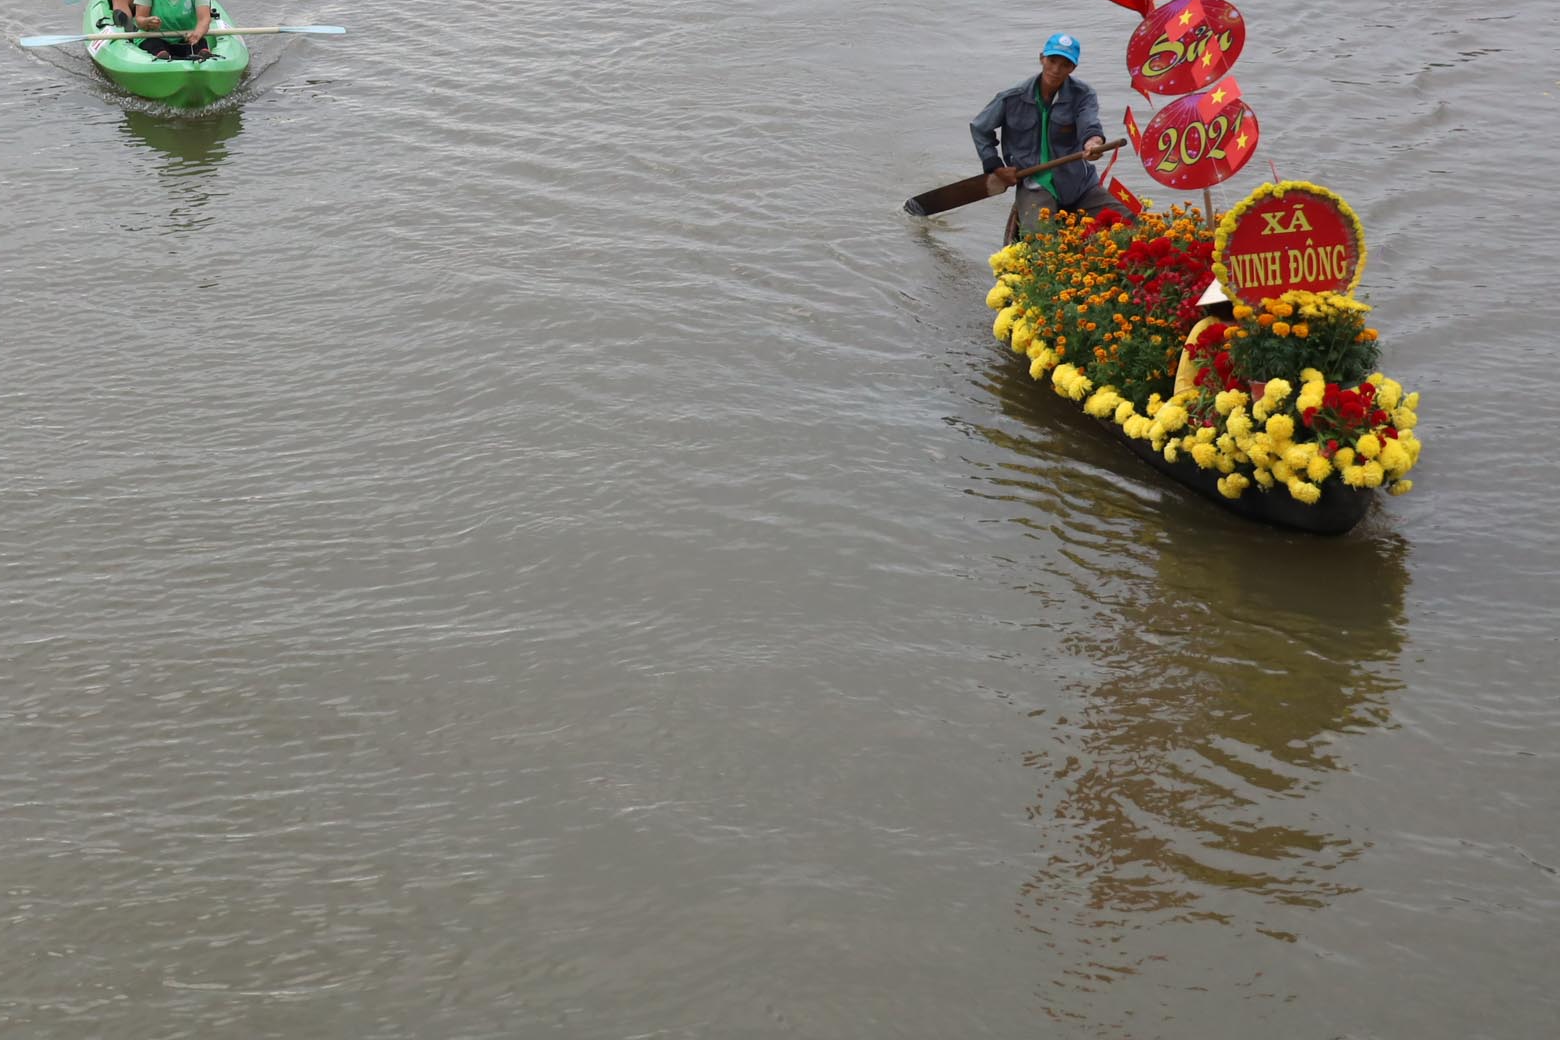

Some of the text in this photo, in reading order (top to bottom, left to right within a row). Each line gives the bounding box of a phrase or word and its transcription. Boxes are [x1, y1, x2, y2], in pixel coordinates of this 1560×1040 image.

[1261, 204, 1313, 235] XÃ
[1230, 238, 1348, 289] NINH ĐÔNG
